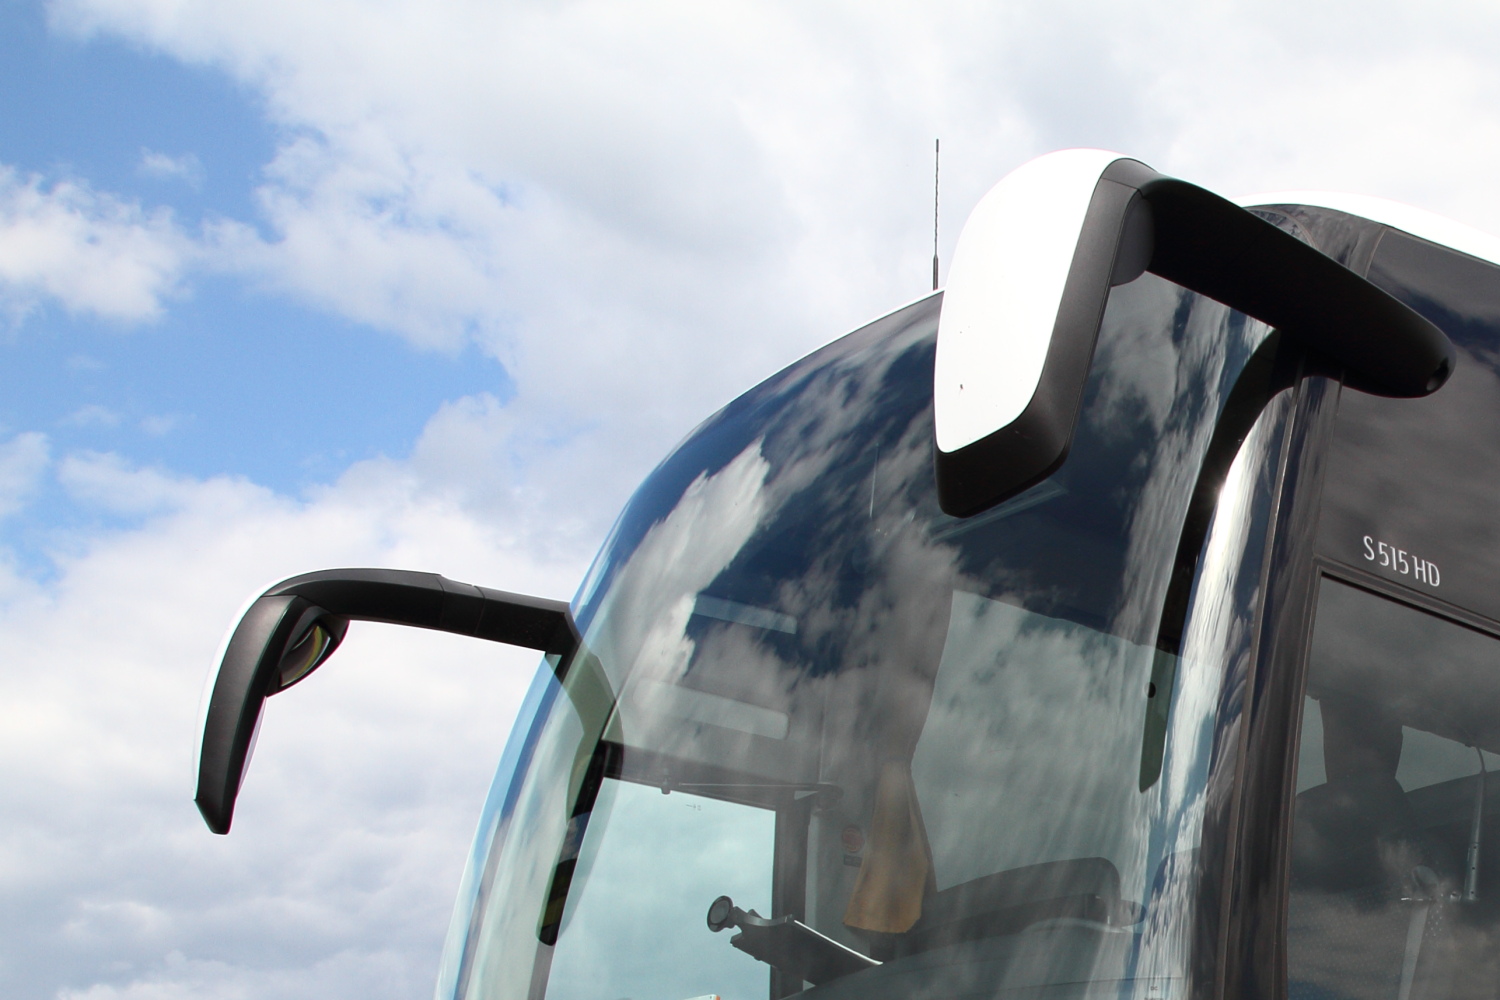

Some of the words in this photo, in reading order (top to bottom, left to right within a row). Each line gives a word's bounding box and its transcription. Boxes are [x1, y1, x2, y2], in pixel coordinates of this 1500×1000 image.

[1363, 535, 1375, 561] S
[1378, 541, 1409, 575] 515
[1412, 555, 1440, 587] HD
